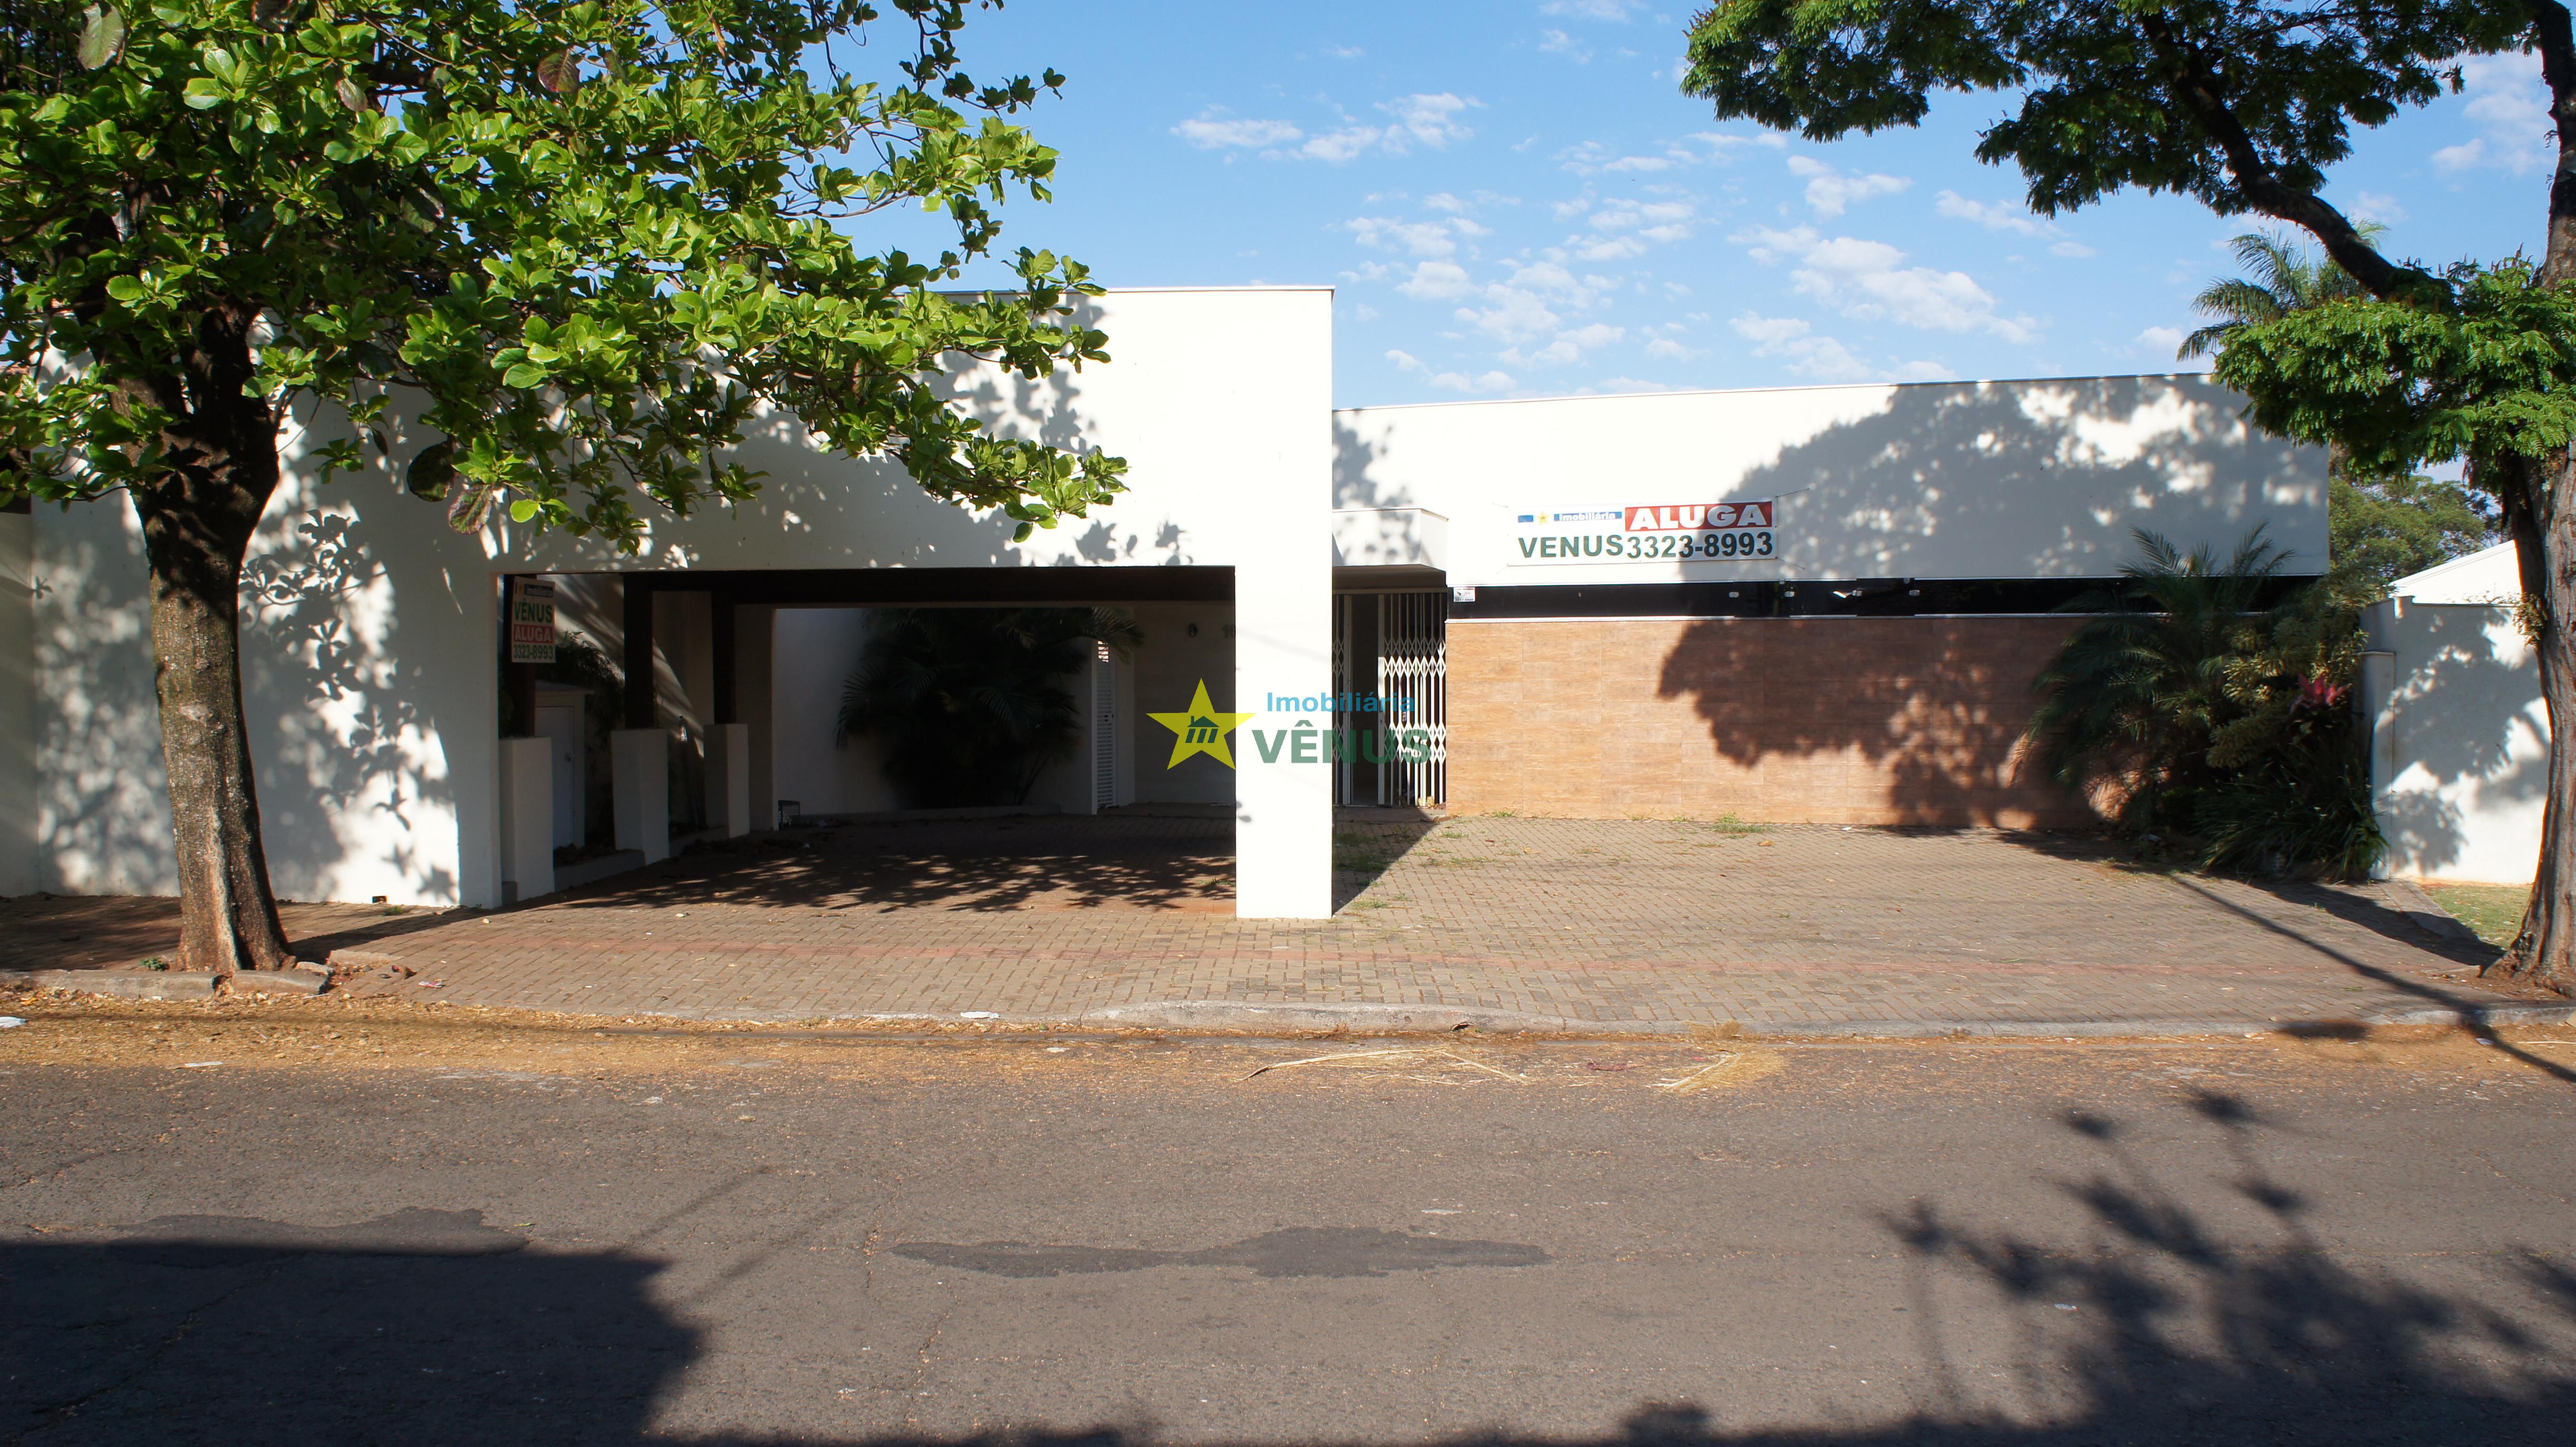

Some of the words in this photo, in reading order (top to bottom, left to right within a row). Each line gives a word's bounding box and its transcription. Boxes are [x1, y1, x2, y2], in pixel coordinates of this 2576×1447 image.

[1559, 512, 1616, 521] Imobiliária
[1629, 504, 1767, 531] ALUGA
[1518, 534, 1624, 558] VENUS
[1627, 532, 1773, 559] 3323-8993
[514, 598, 553, 623] VÊNUS
[514, 627, 551, 642] ALUGA
[513, 644, 553, 660] 3323-8993
